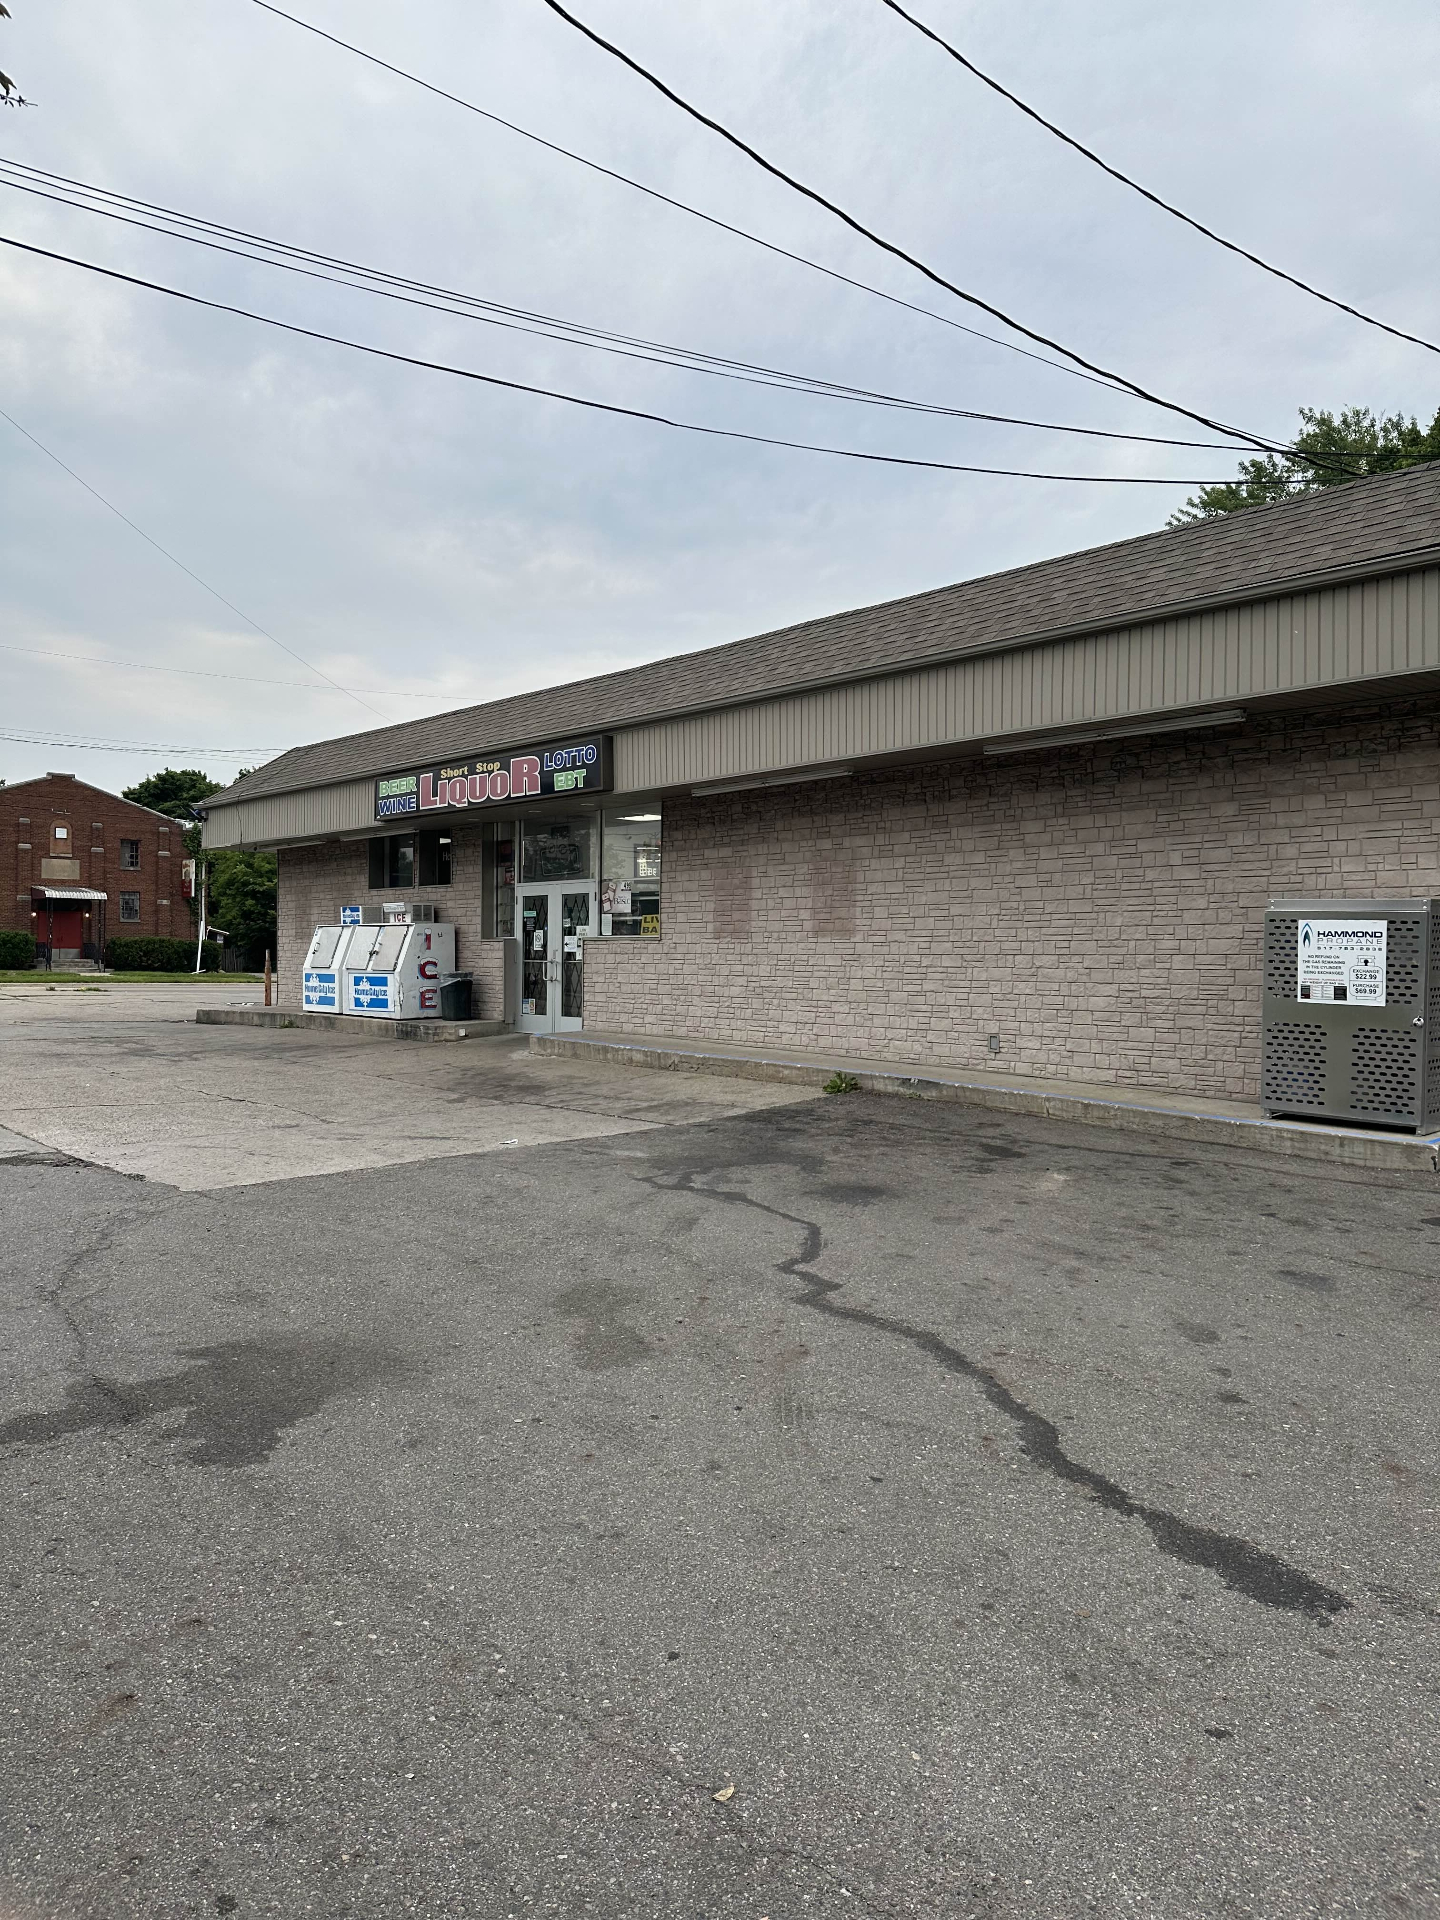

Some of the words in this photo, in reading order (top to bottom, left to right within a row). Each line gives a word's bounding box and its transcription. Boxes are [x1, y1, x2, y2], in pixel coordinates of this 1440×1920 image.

[544, 745, 596, 770] LOTTO
[441, 766, 468, 779] Short
[476, 761, 500, 773] Stop
[379, 776, 417, 797] BEER
[420, 755, 541, 810] LIQUOR
[554, 769, 587, 791] EBT
[378, 795, 416, 815] WINE
[394, 914, 406, 922] ICE
[1317, 930, 1383, 938] HAMMOND
[304, 984, 318, 993] Home
[354, 988, 368, 996] Home
[380, 988, 388, 996] Ice
